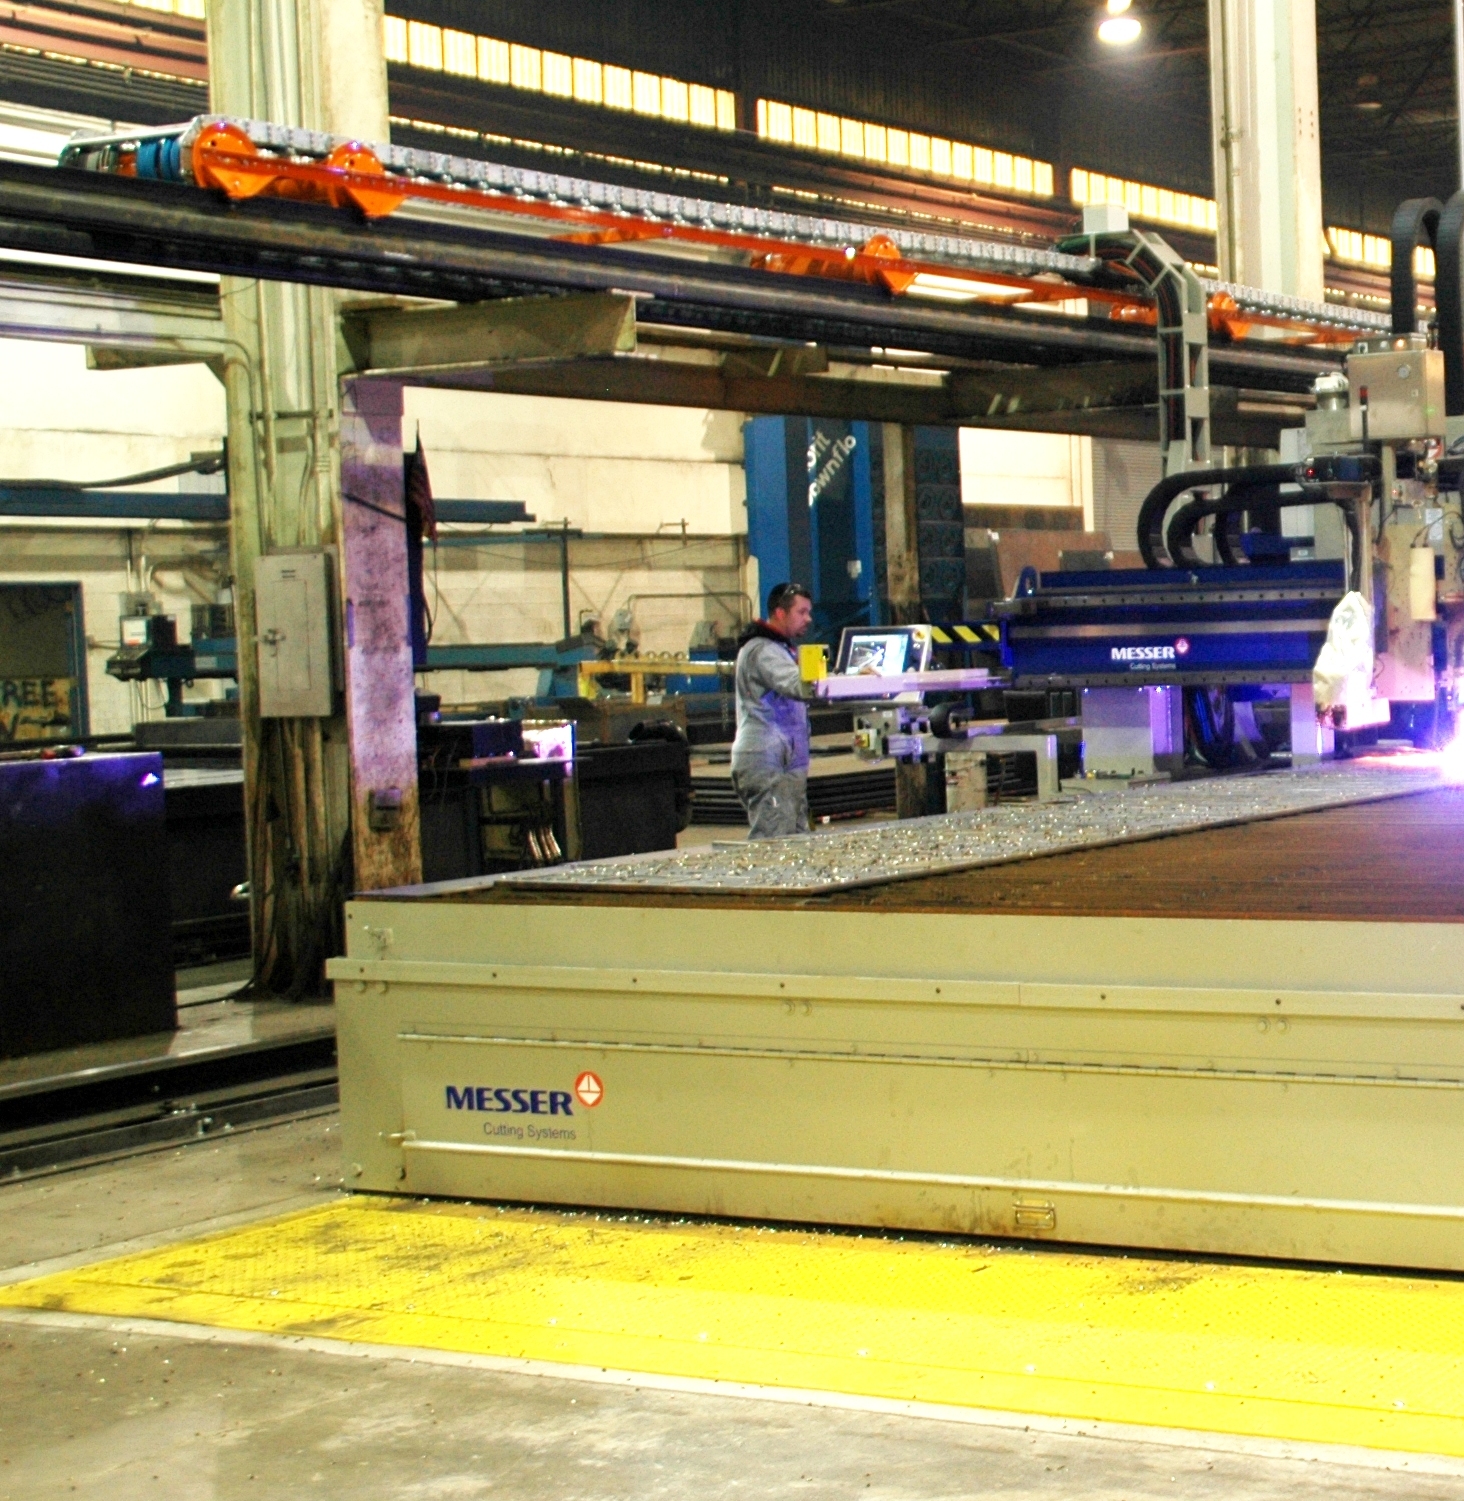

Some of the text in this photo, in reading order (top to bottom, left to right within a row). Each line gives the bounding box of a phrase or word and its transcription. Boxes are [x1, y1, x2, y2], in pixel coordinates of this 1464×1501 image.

[1111, 646, 1176, 660] MESSER
[2, 679, 57, 707] REE
[446, 1085, 574, 1116] MESSER
[483, 1122, 577, 1140] Cutting Systems
